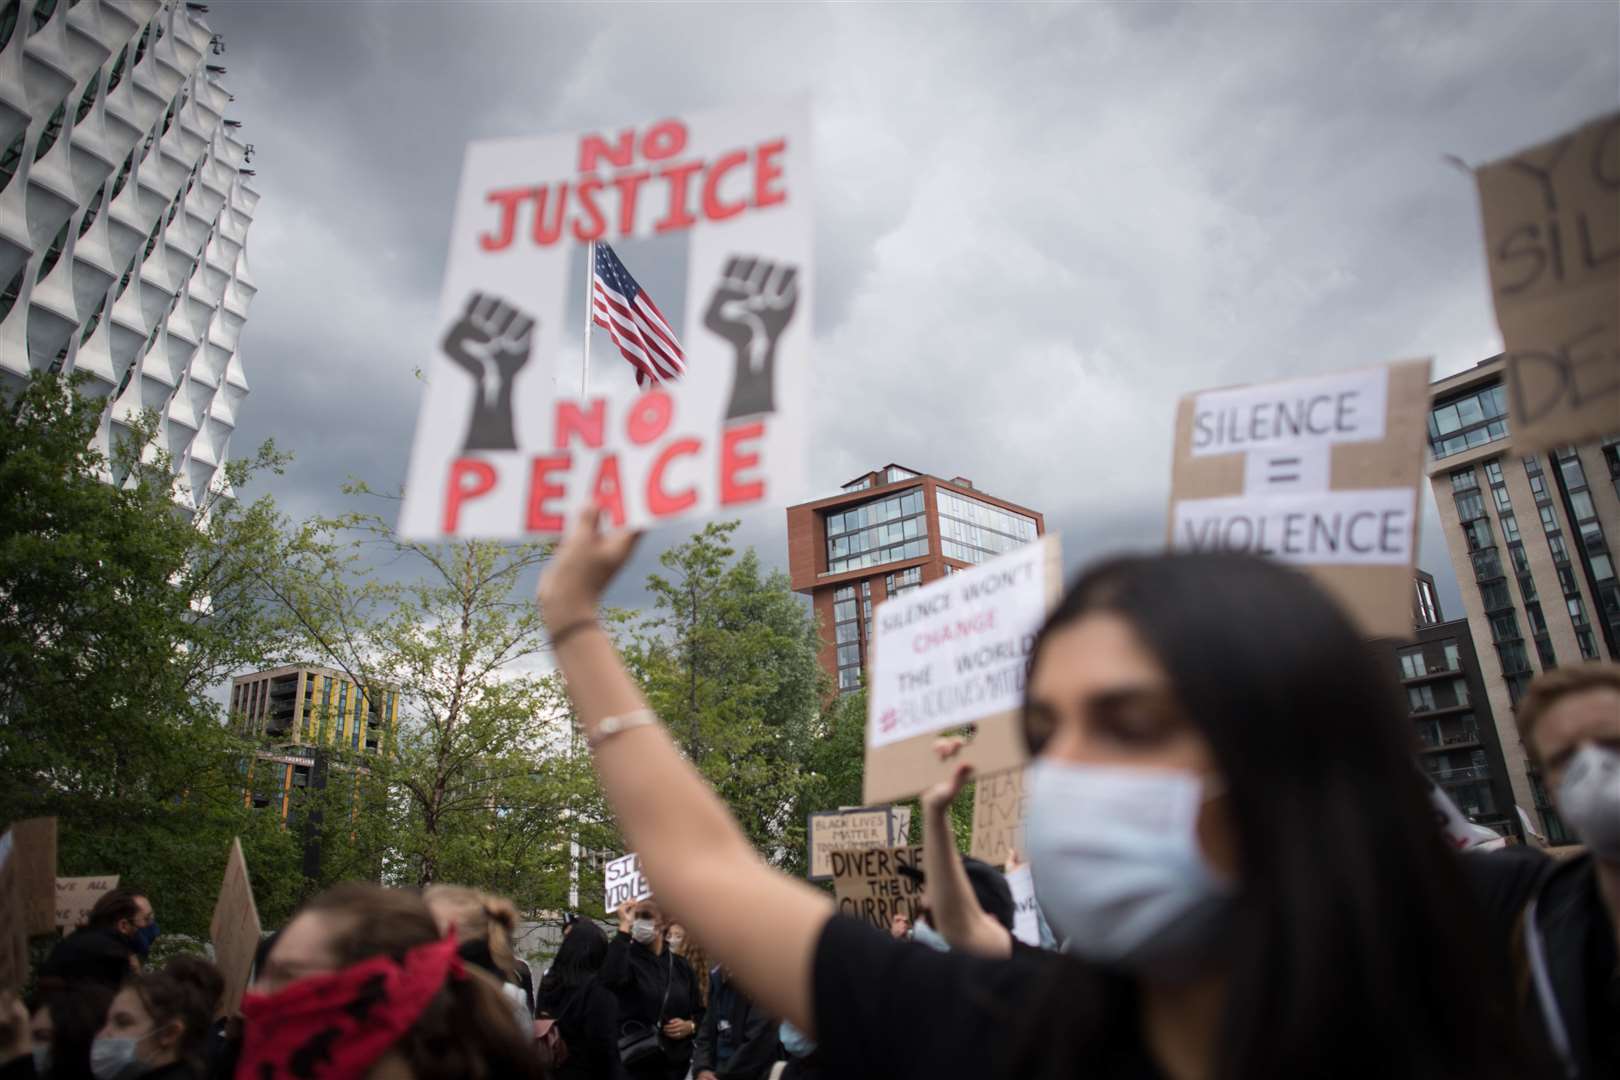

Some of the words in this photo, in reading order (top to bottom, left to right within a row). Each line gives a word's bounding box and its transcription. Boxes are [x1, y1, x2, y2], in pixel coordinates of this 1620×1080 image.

[579, 119, 688, 171] NO
[480, 140, 787, 252] JUSTICE
[554, 389, 673, 449] NO
[1194, 391, 1359, 446] SILENCE
[442, 423, 765, 534] PEACE
[1185, 509, 1405, 555] VIOLENCE
[882, 592, 950, 634] SILENCE
[962, 562, 1034, 600] WON'T
[913, 610, 994, 653] CHANGE
[899, 665, 931, 691] THE
[816, 819, 848, 831] BLACK
[852, 816, 884, 828] LIVES
[833, 829, 879, 840] MATTER
[87, 881, 107, 890] ALL
[867, 880, 900, 895] THE
